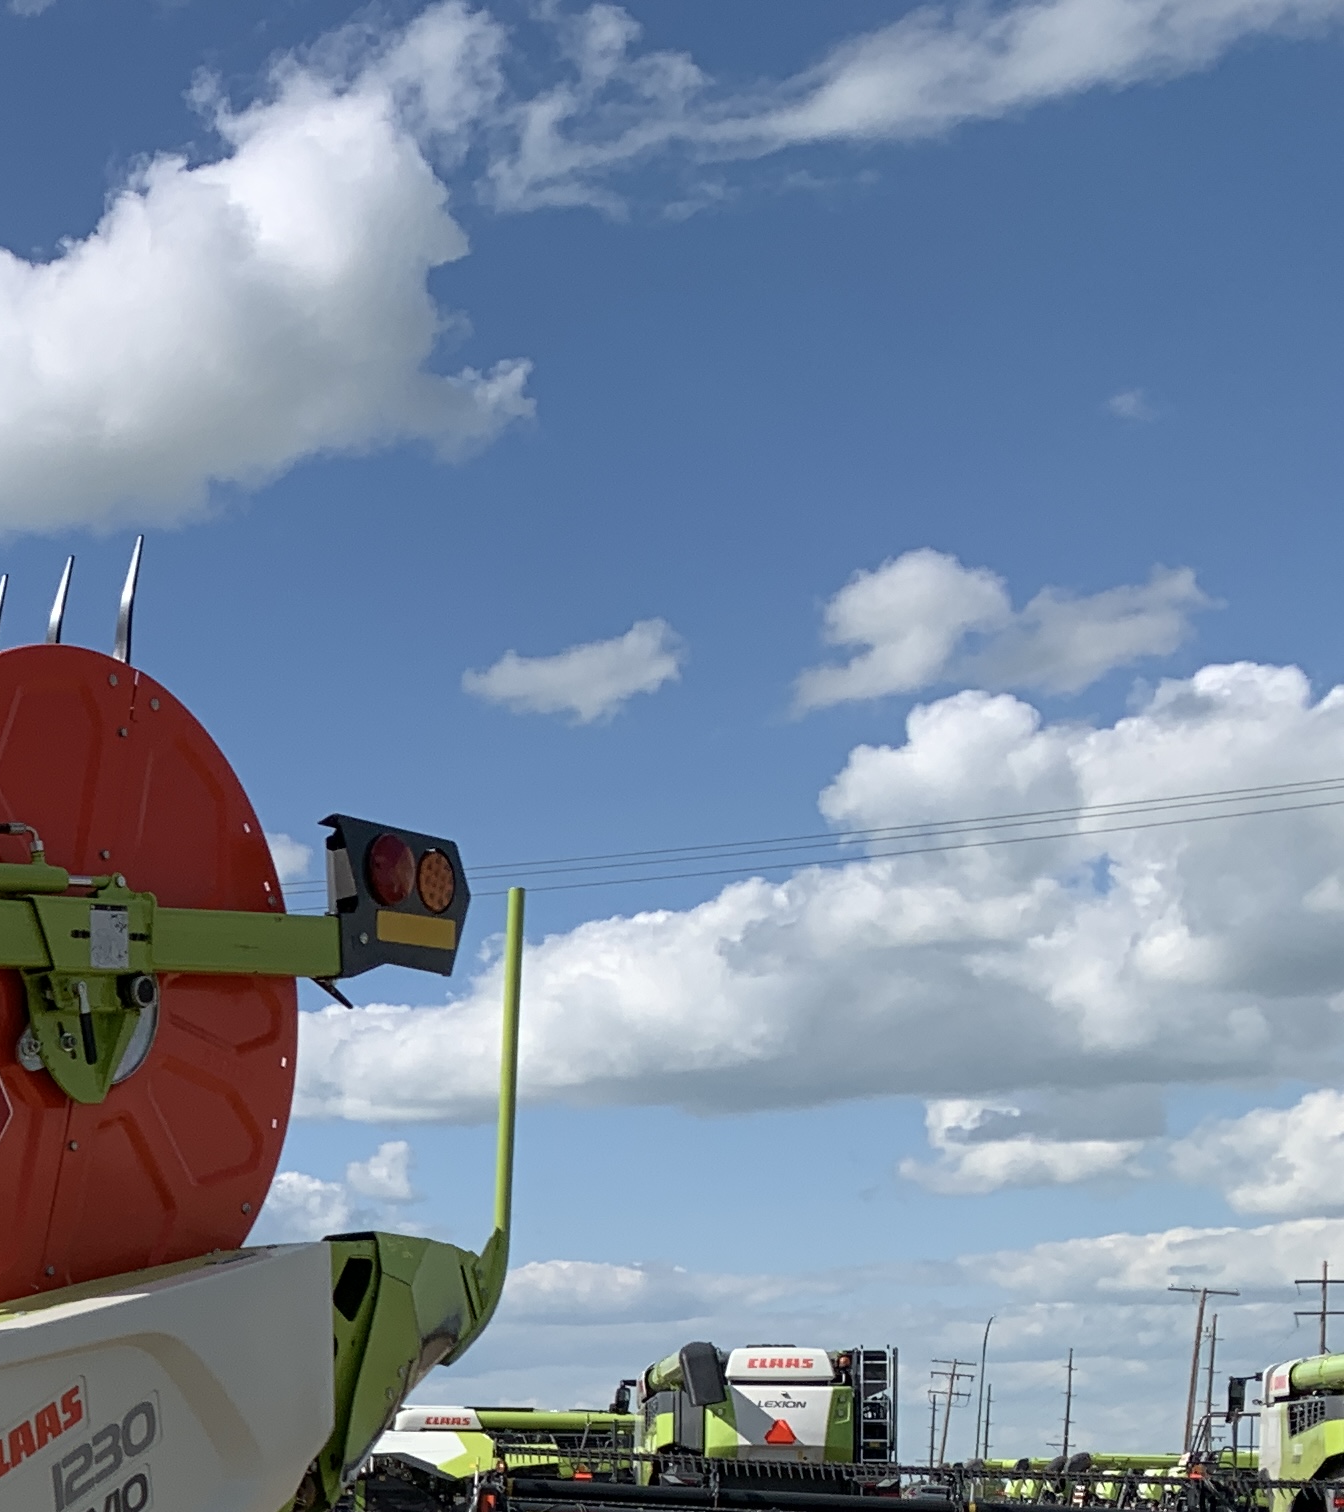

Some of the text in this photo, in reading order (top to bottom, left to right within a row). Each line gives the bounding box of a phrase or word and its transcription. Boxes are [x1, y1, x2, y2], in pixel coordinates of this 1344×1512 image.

[746, 1358, 814, 1369] CLAAS
[757, 1400, 807, 1409] LEXION
[425, 1416, 471, 1426] CLAAS
[52, 1401, 157, 1512] 1230
